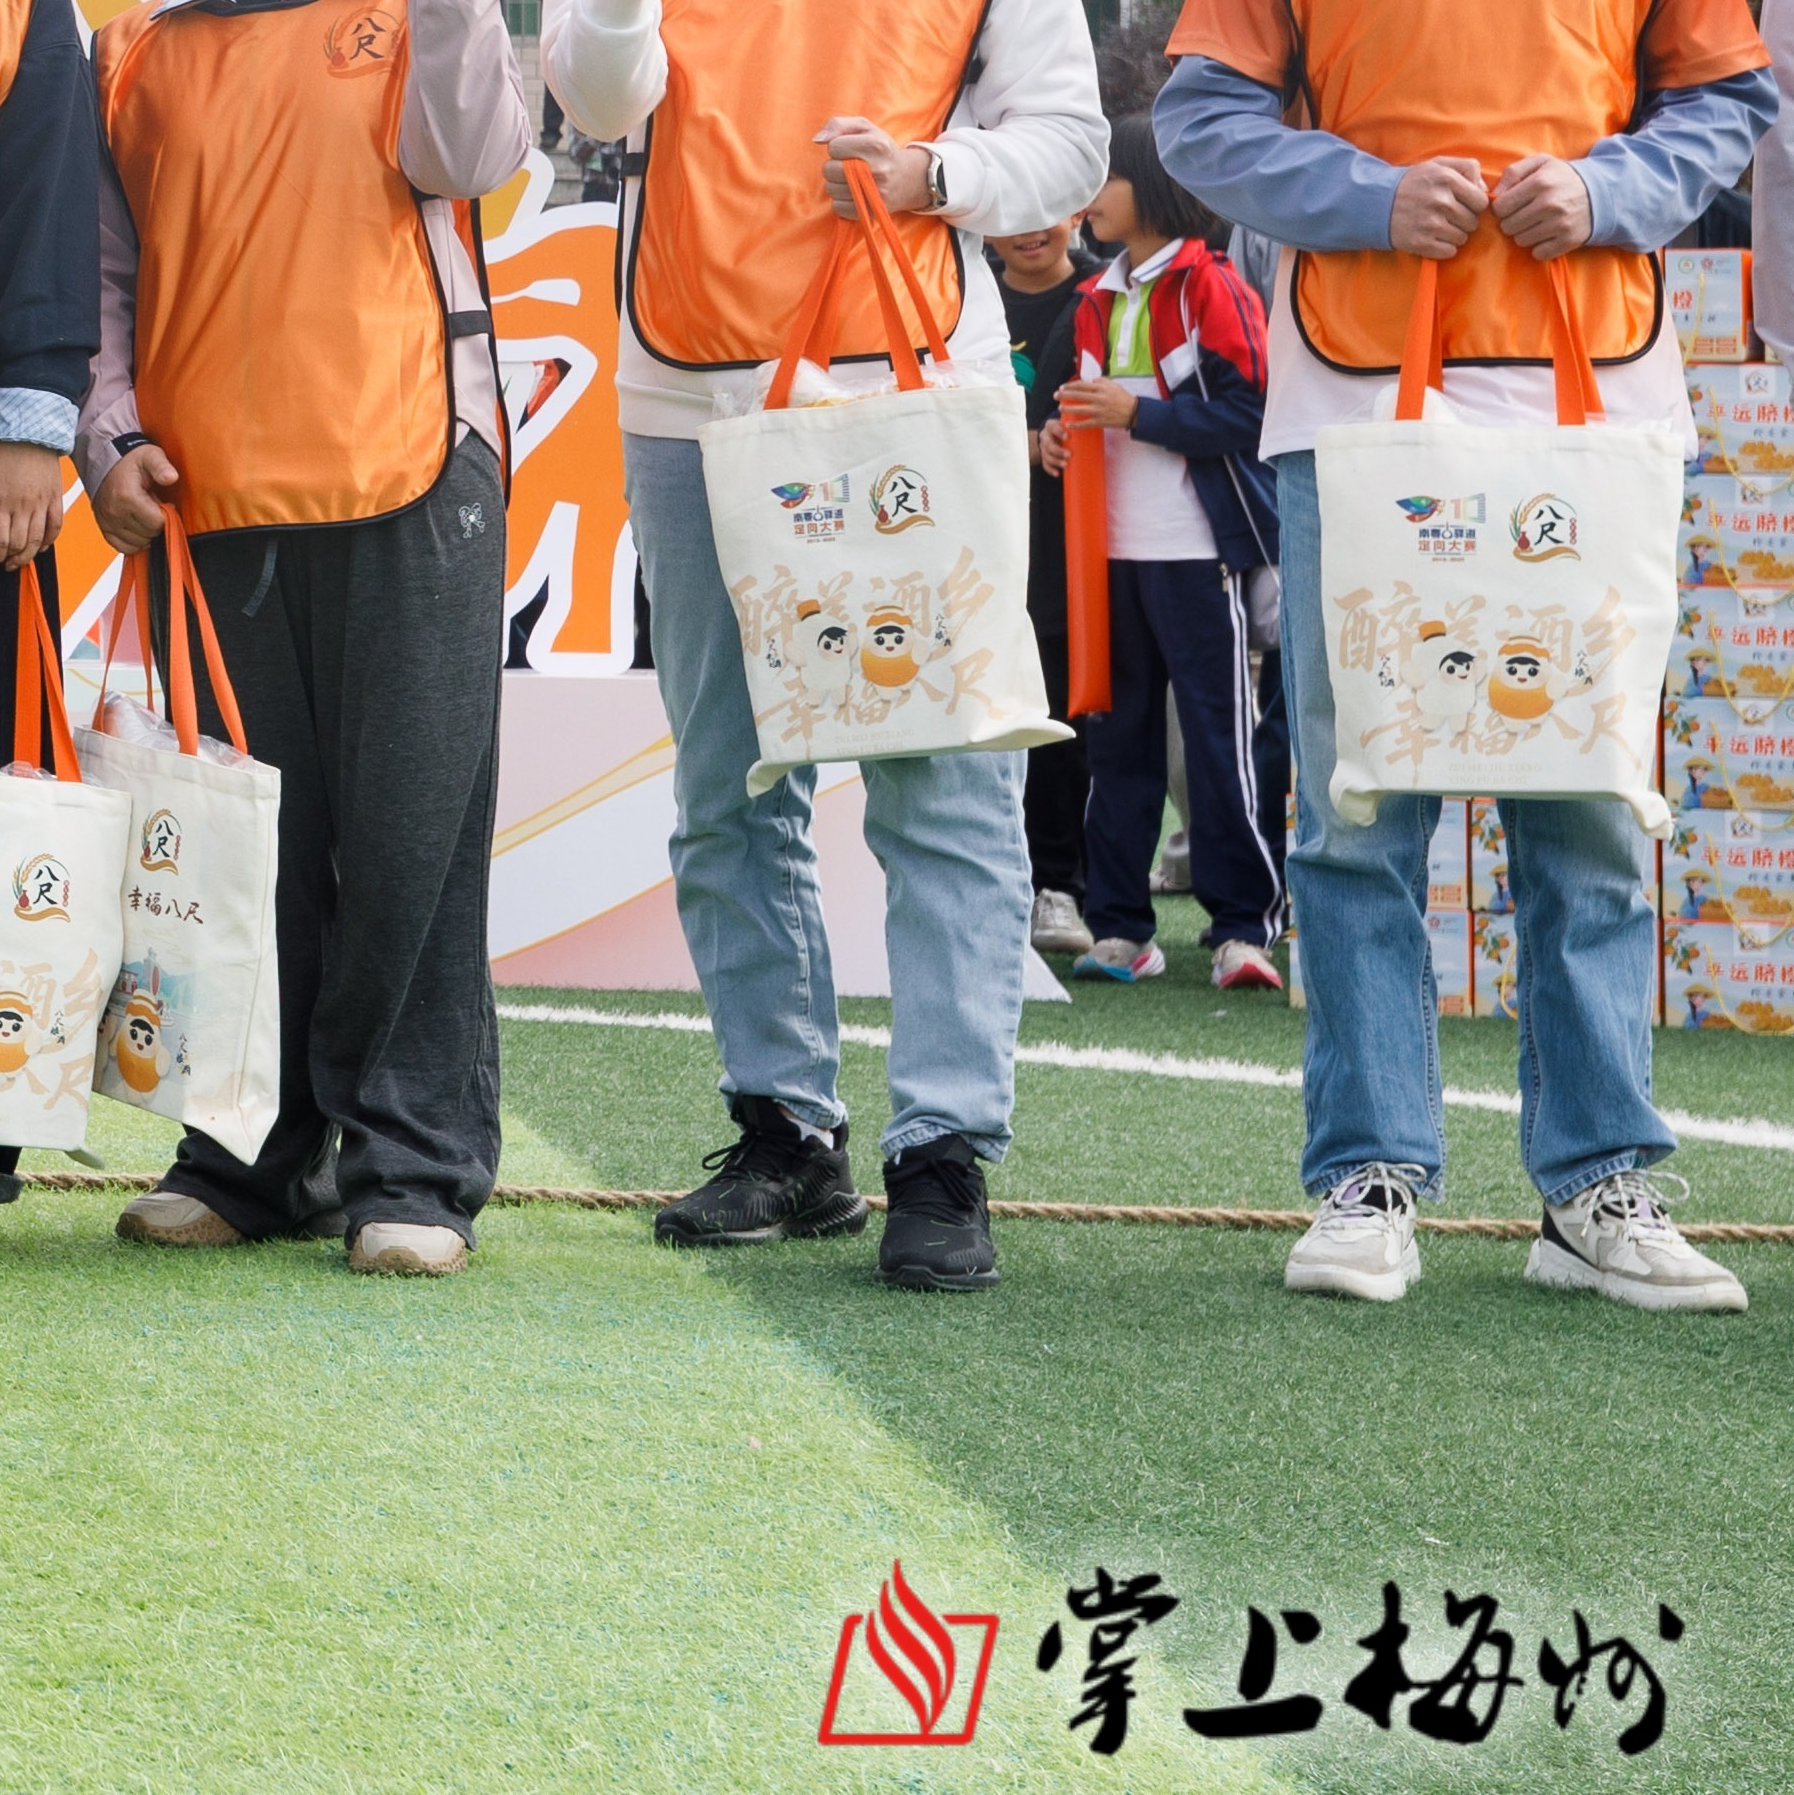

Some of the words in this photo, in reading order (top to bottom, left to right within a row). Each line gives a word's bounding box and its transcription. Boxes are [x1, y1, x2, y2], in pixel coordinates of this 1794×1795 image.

[349, 17, 387, 60] 八尺
[890, 476, 918, 517] 八尺
[1533, 505, 1565, 546] 八尺
[152, 818, 174, 858] 八尺
[33, 865, 60, 905] 八尺
[127, 886, 204, 925] 幸福八尺
